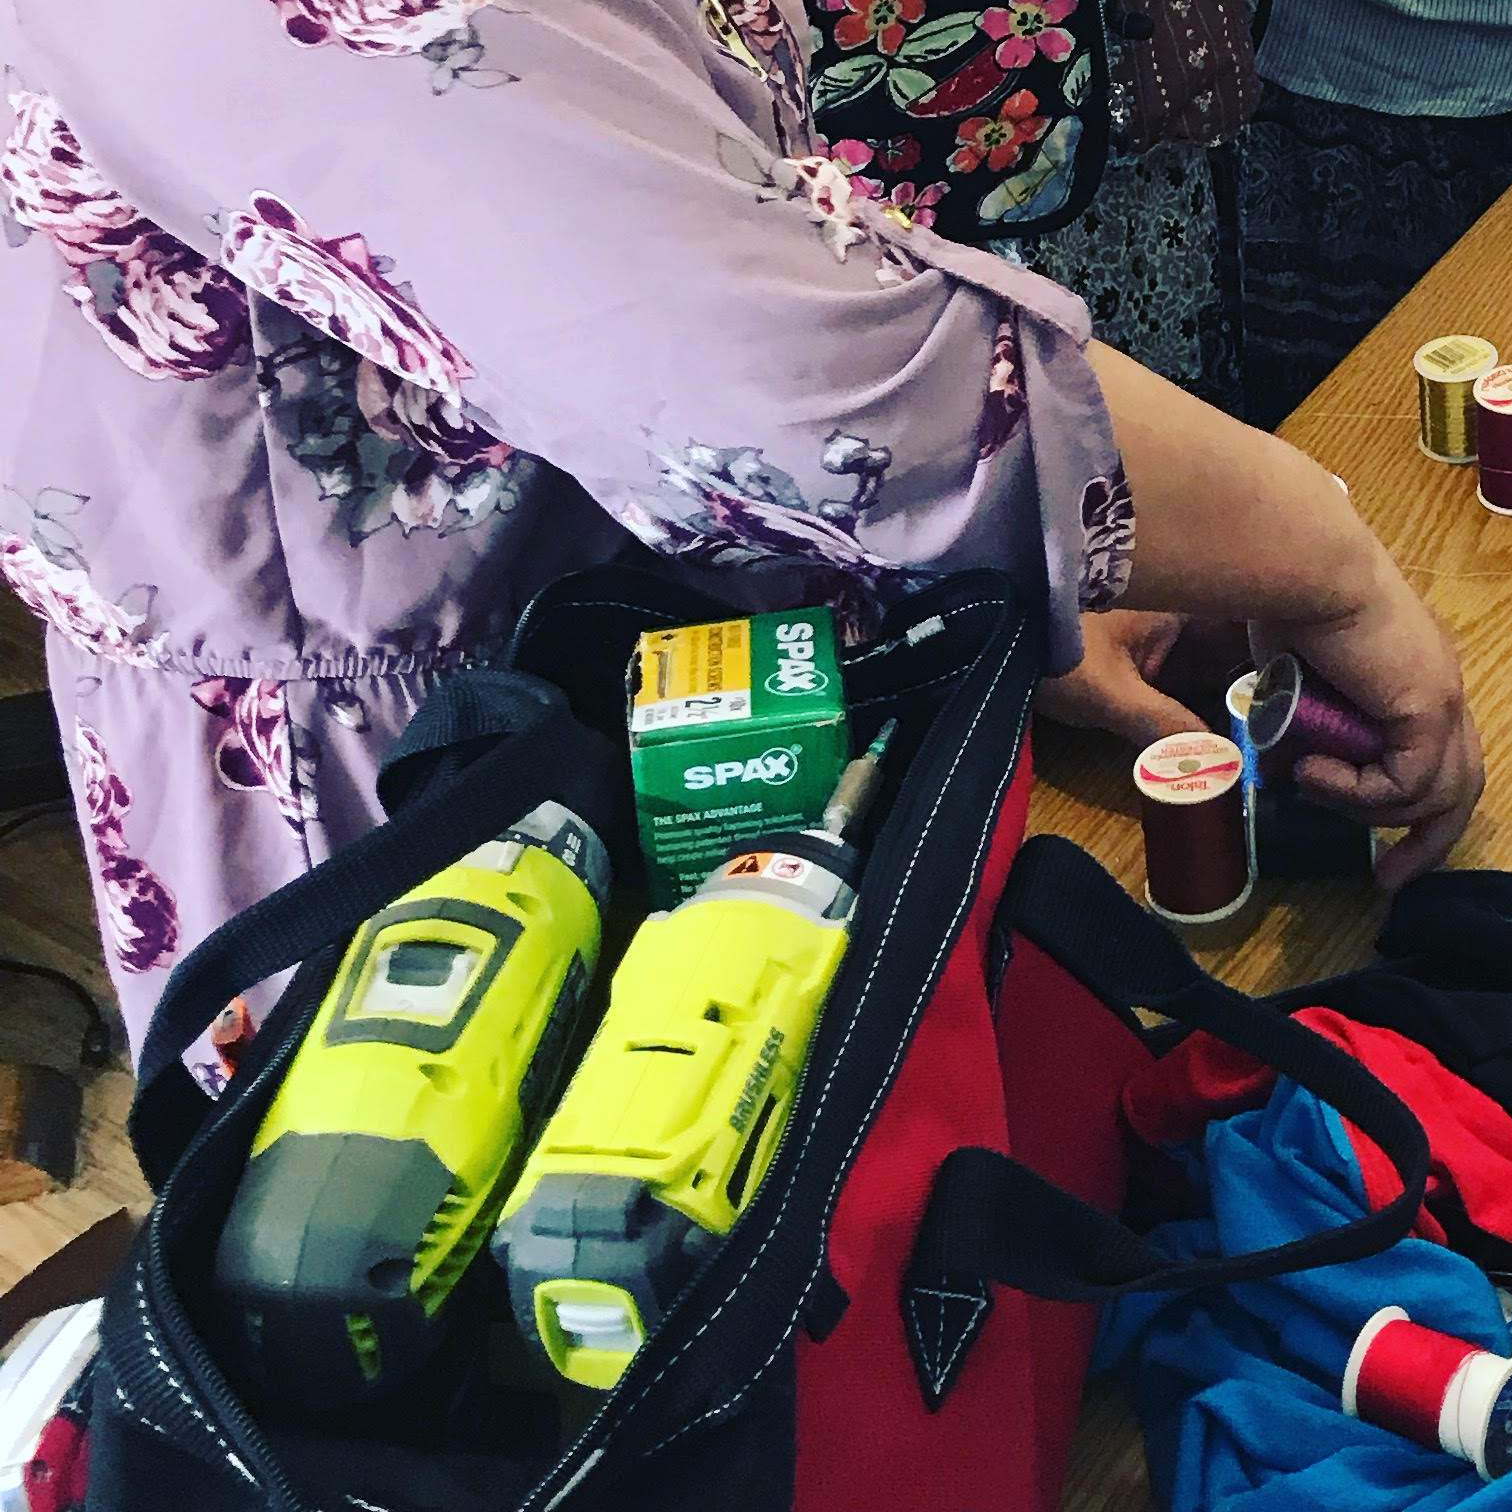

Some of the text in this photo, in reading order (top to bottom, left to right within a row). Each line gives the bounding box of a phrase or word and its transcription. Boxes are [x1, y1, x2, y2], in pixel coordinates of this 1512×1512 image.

[775, 621, 821, 694] SPAX
[683, 748, 798, 790] SPAX
[653, 801, 763, 826] THE SPAX ADVANTAGE
[730, 1026, 785, 1134] BRUSHLESS
